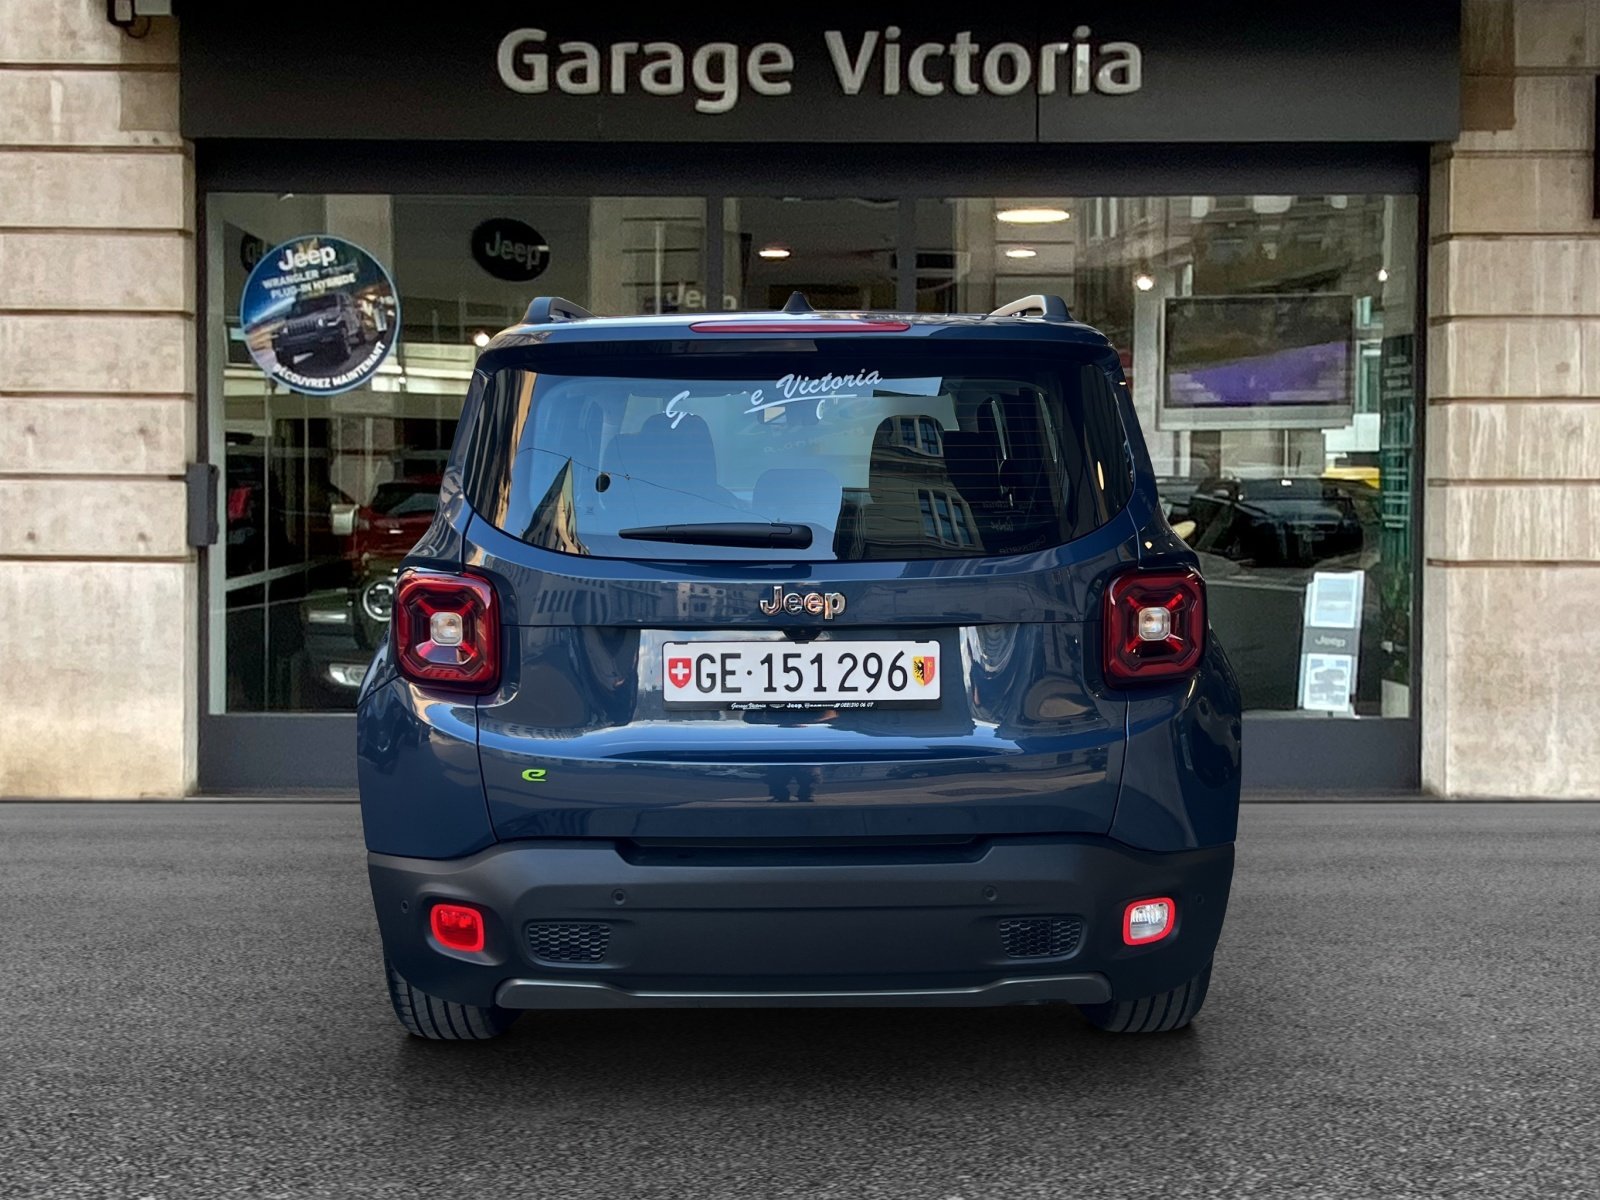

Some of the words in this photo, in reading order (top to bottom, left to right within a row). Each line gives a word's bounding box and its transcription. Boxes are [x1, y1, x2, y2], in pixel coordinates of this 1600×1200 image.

[498, 28, 794, 113] Garage
[824, 25, 1142, 96] Victoria
[278, 246, 336, 270] Jeep
[485, 231, 541, 270] Jeep
[262, 270, 320, 289] WRANGLER
[272, 363, 331, 388] DÉCOUVREZ
[332, 341, 386, 387] MAINTENANT
[776, 368, 883, 399] Victoria
[759, 585, 847, 621] Jeep
